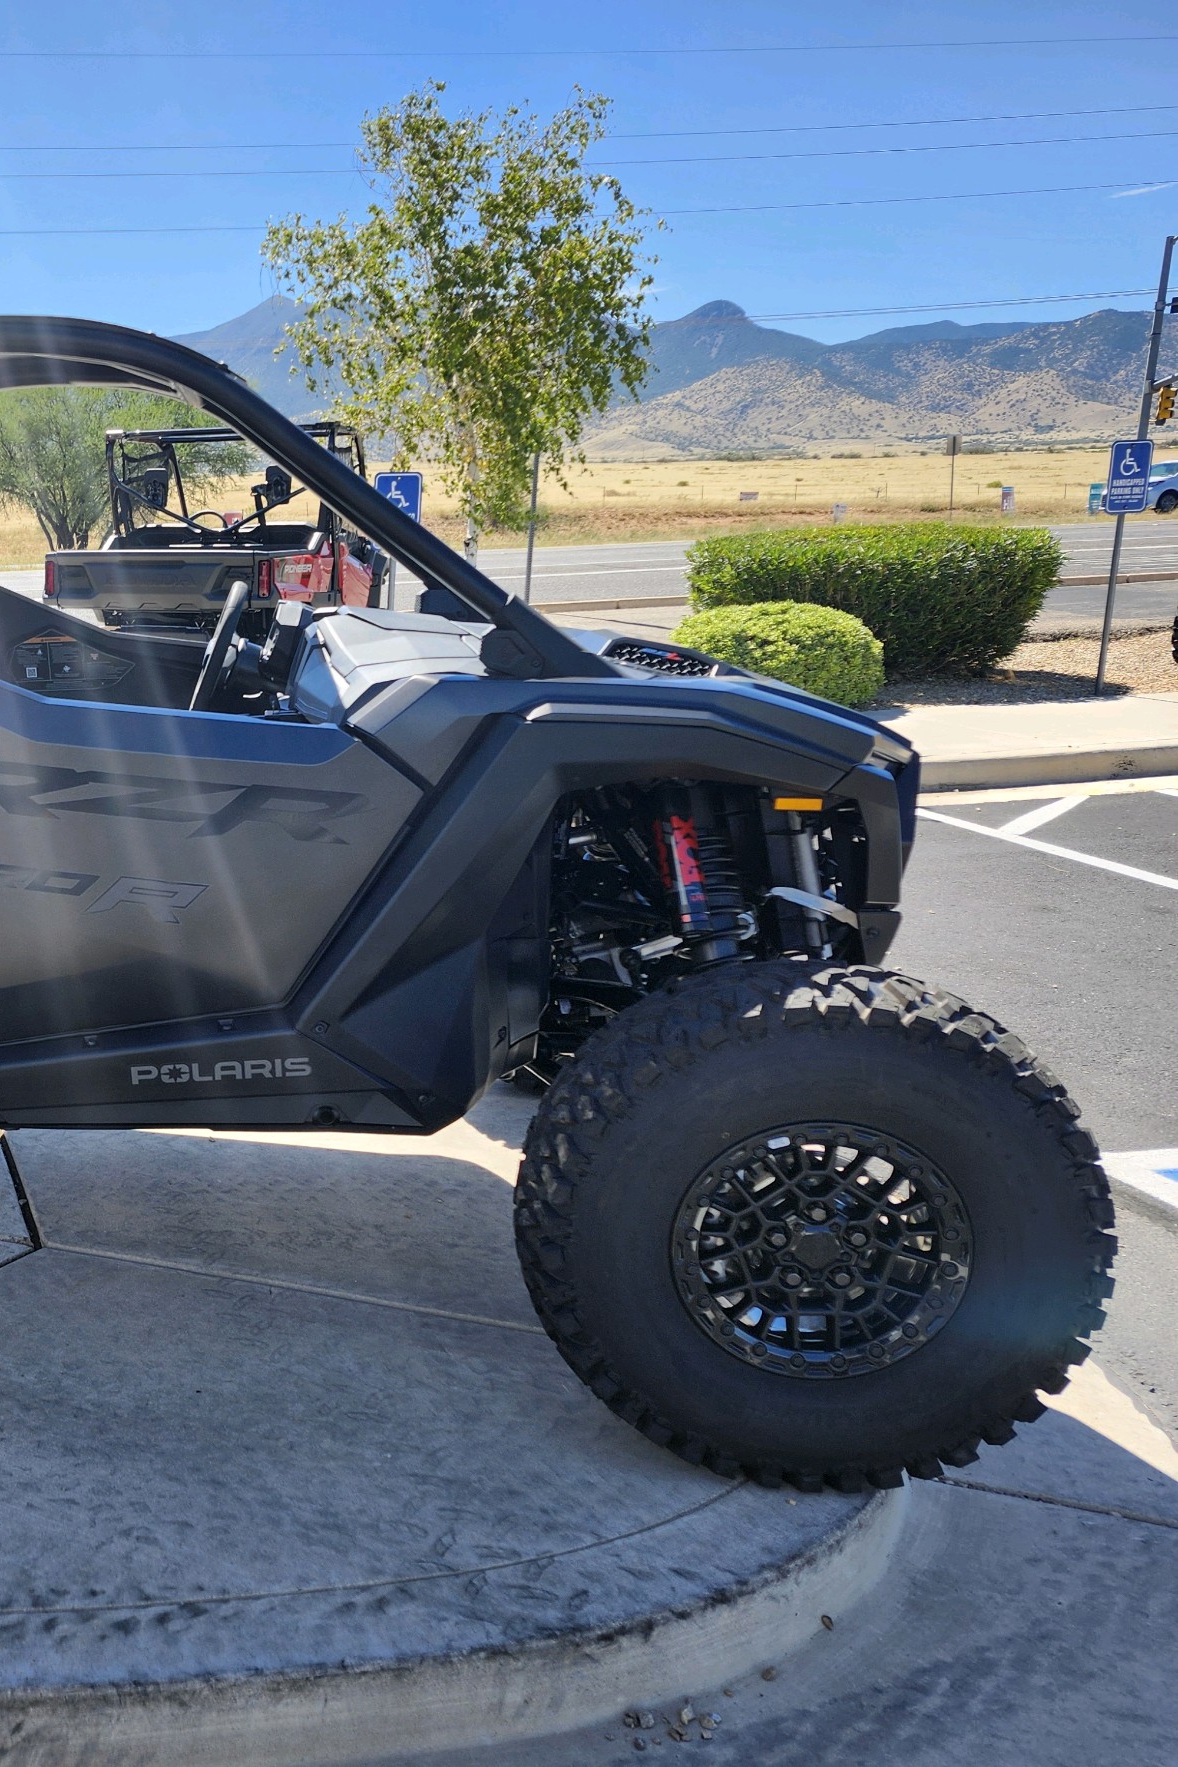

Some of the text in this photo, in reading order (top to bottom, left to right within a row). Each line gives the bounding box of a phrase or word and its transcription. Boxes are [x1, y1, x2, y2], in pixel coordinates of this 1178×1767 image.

[1111, 487, 1132, 495] PARKING
[1132, 486, 1145, 495] ONLY
[284, 564, 313, 573] PIONEER
[80, 876, 210, 925] R
[130, 1057, 312, 1085] POLARIS
